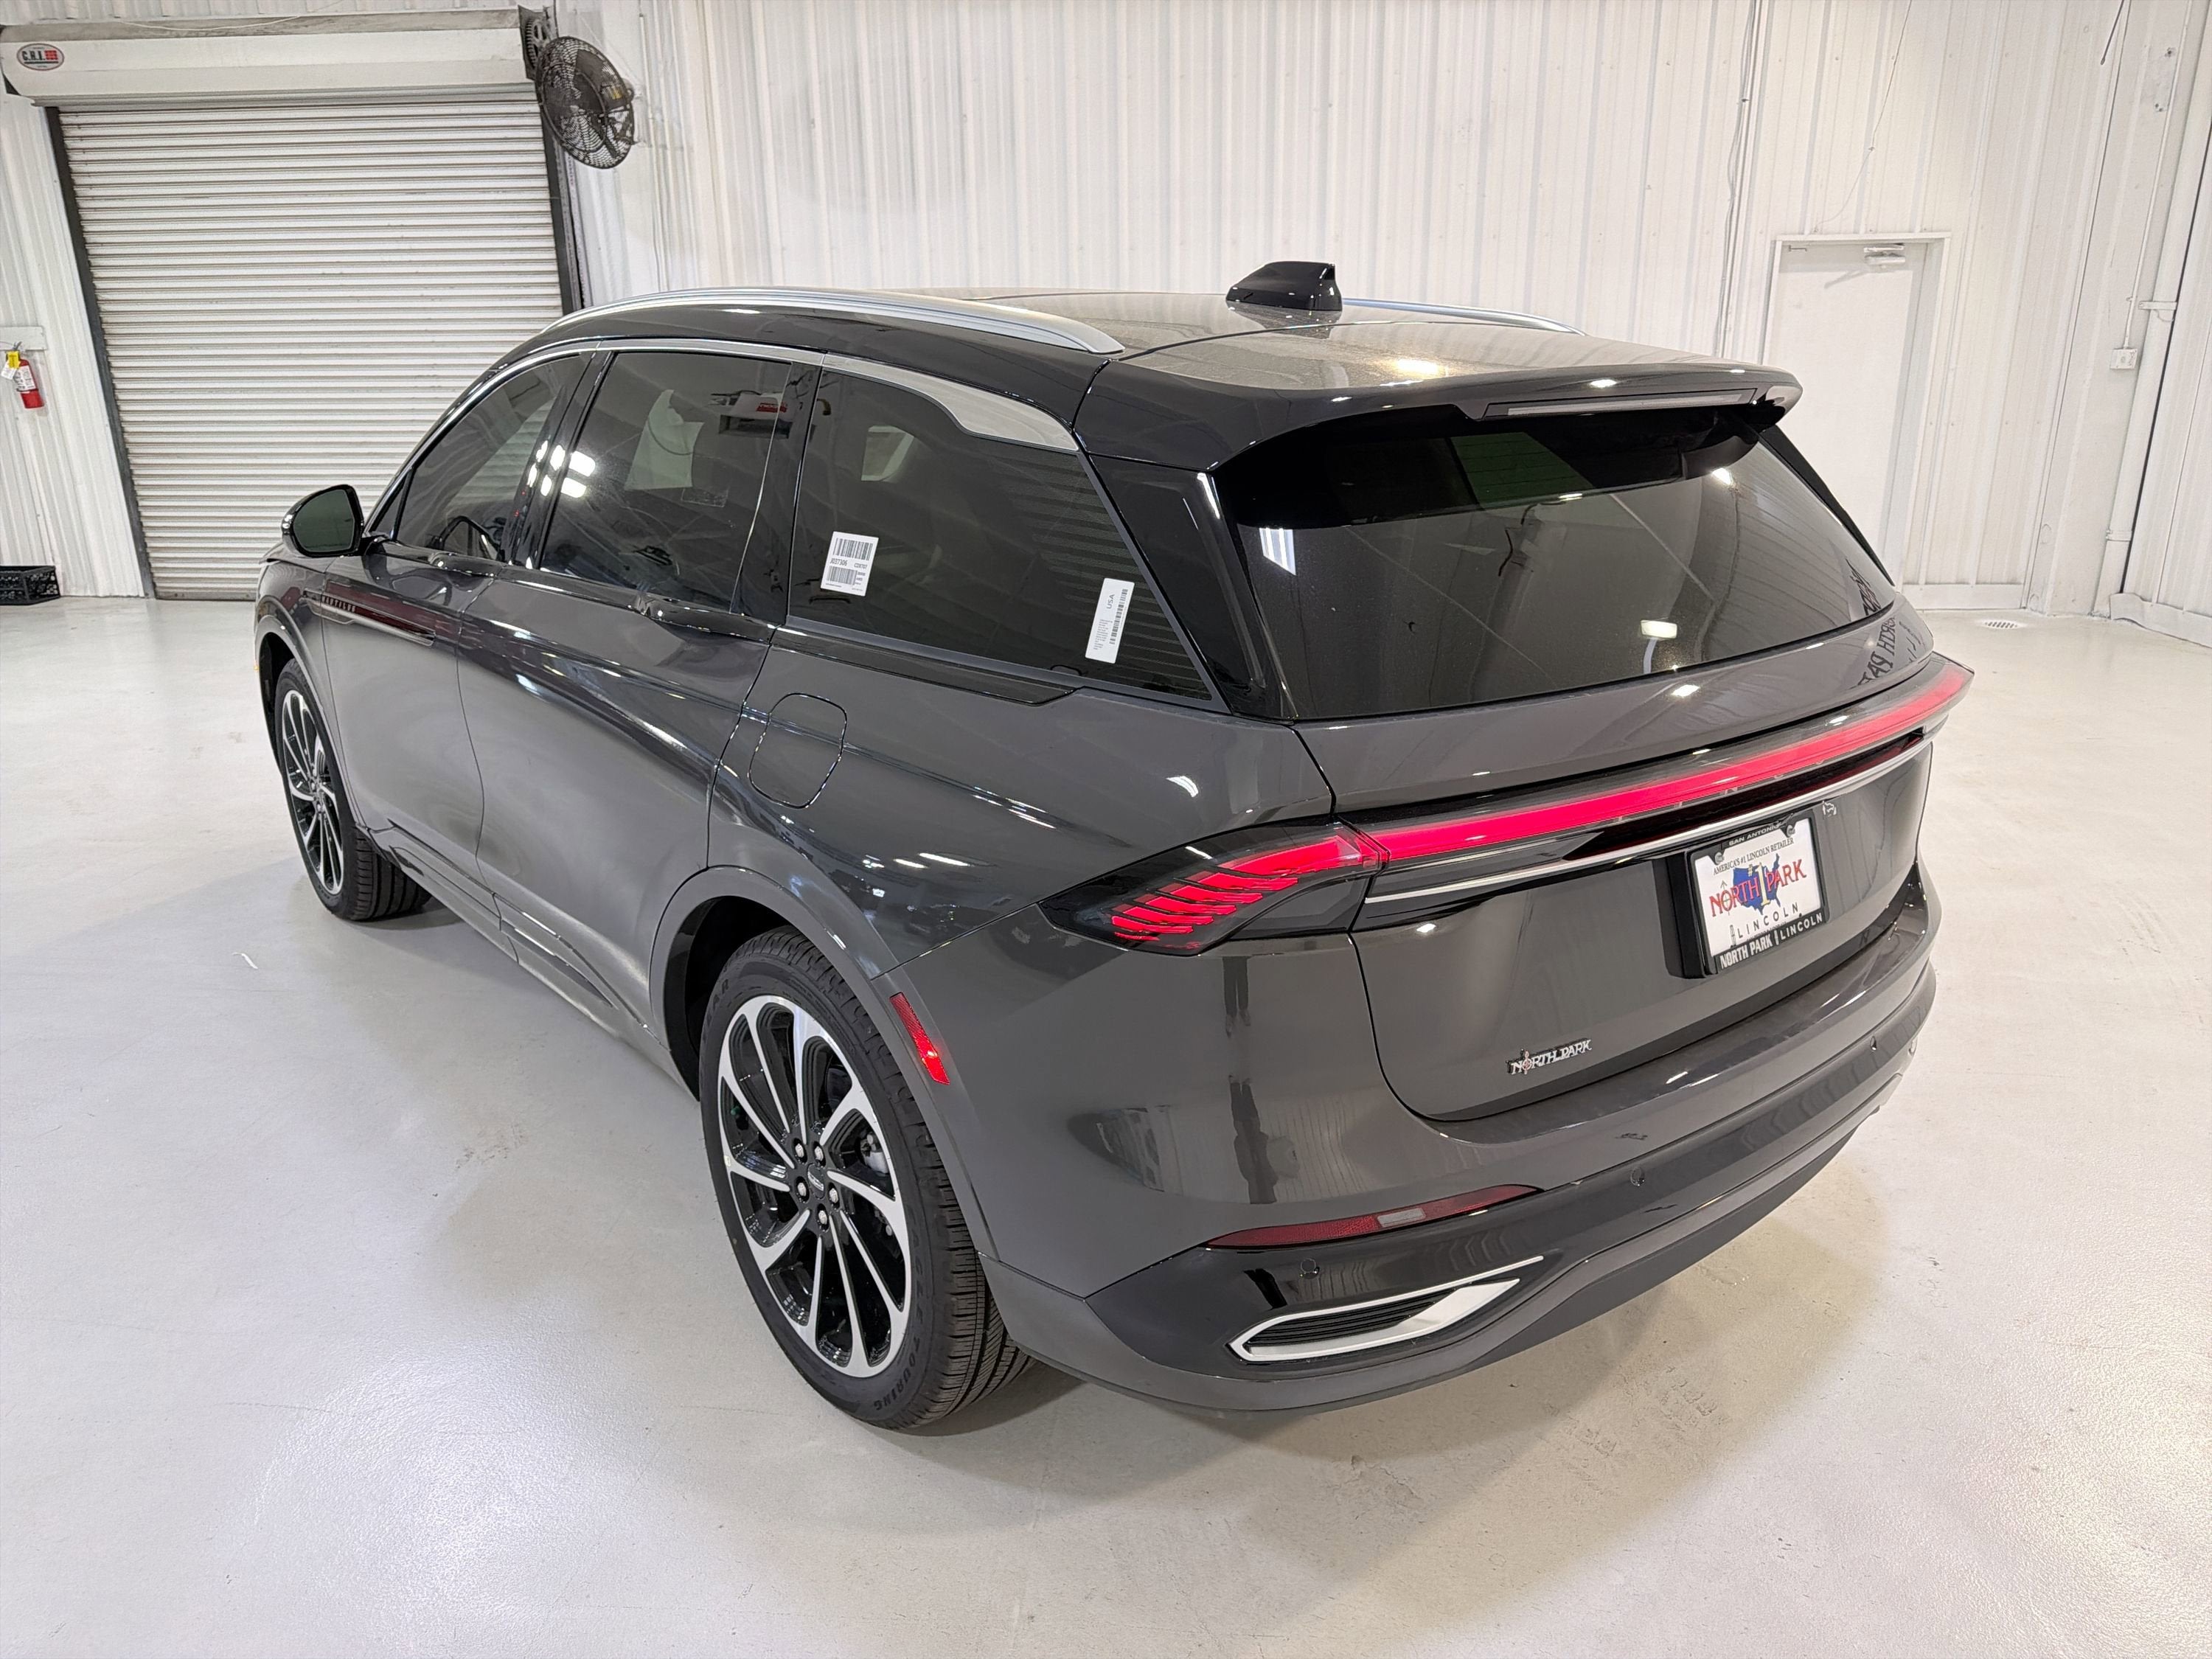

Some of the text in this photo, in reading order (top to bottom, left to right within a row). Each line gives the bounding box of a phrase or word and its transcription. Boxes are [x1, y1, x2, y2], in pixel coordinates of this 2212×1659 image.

[1106, 594, 1116, 610] USA
[1714, 857, 1741, 876] AMERICA'S
[1746, 846, 1771, 863] LINCOLN
[1770, 837, 1795, 852] RETAILER
[1729, 836, 1745, 846] SAN
[1709, 859, 1807, 917] NORTH PARK
[1737, 902, 1799, 939] LINCOLN
[1719, 945, 1750, 970] NORTH
[1749, 933, 1774, 956] PARK
[1780, 912, 1823, 941] LINCOLN
[1511, 1039, 1593, 1075] NORTH PARK
[873, 1335, 921, 1411] TOURING
